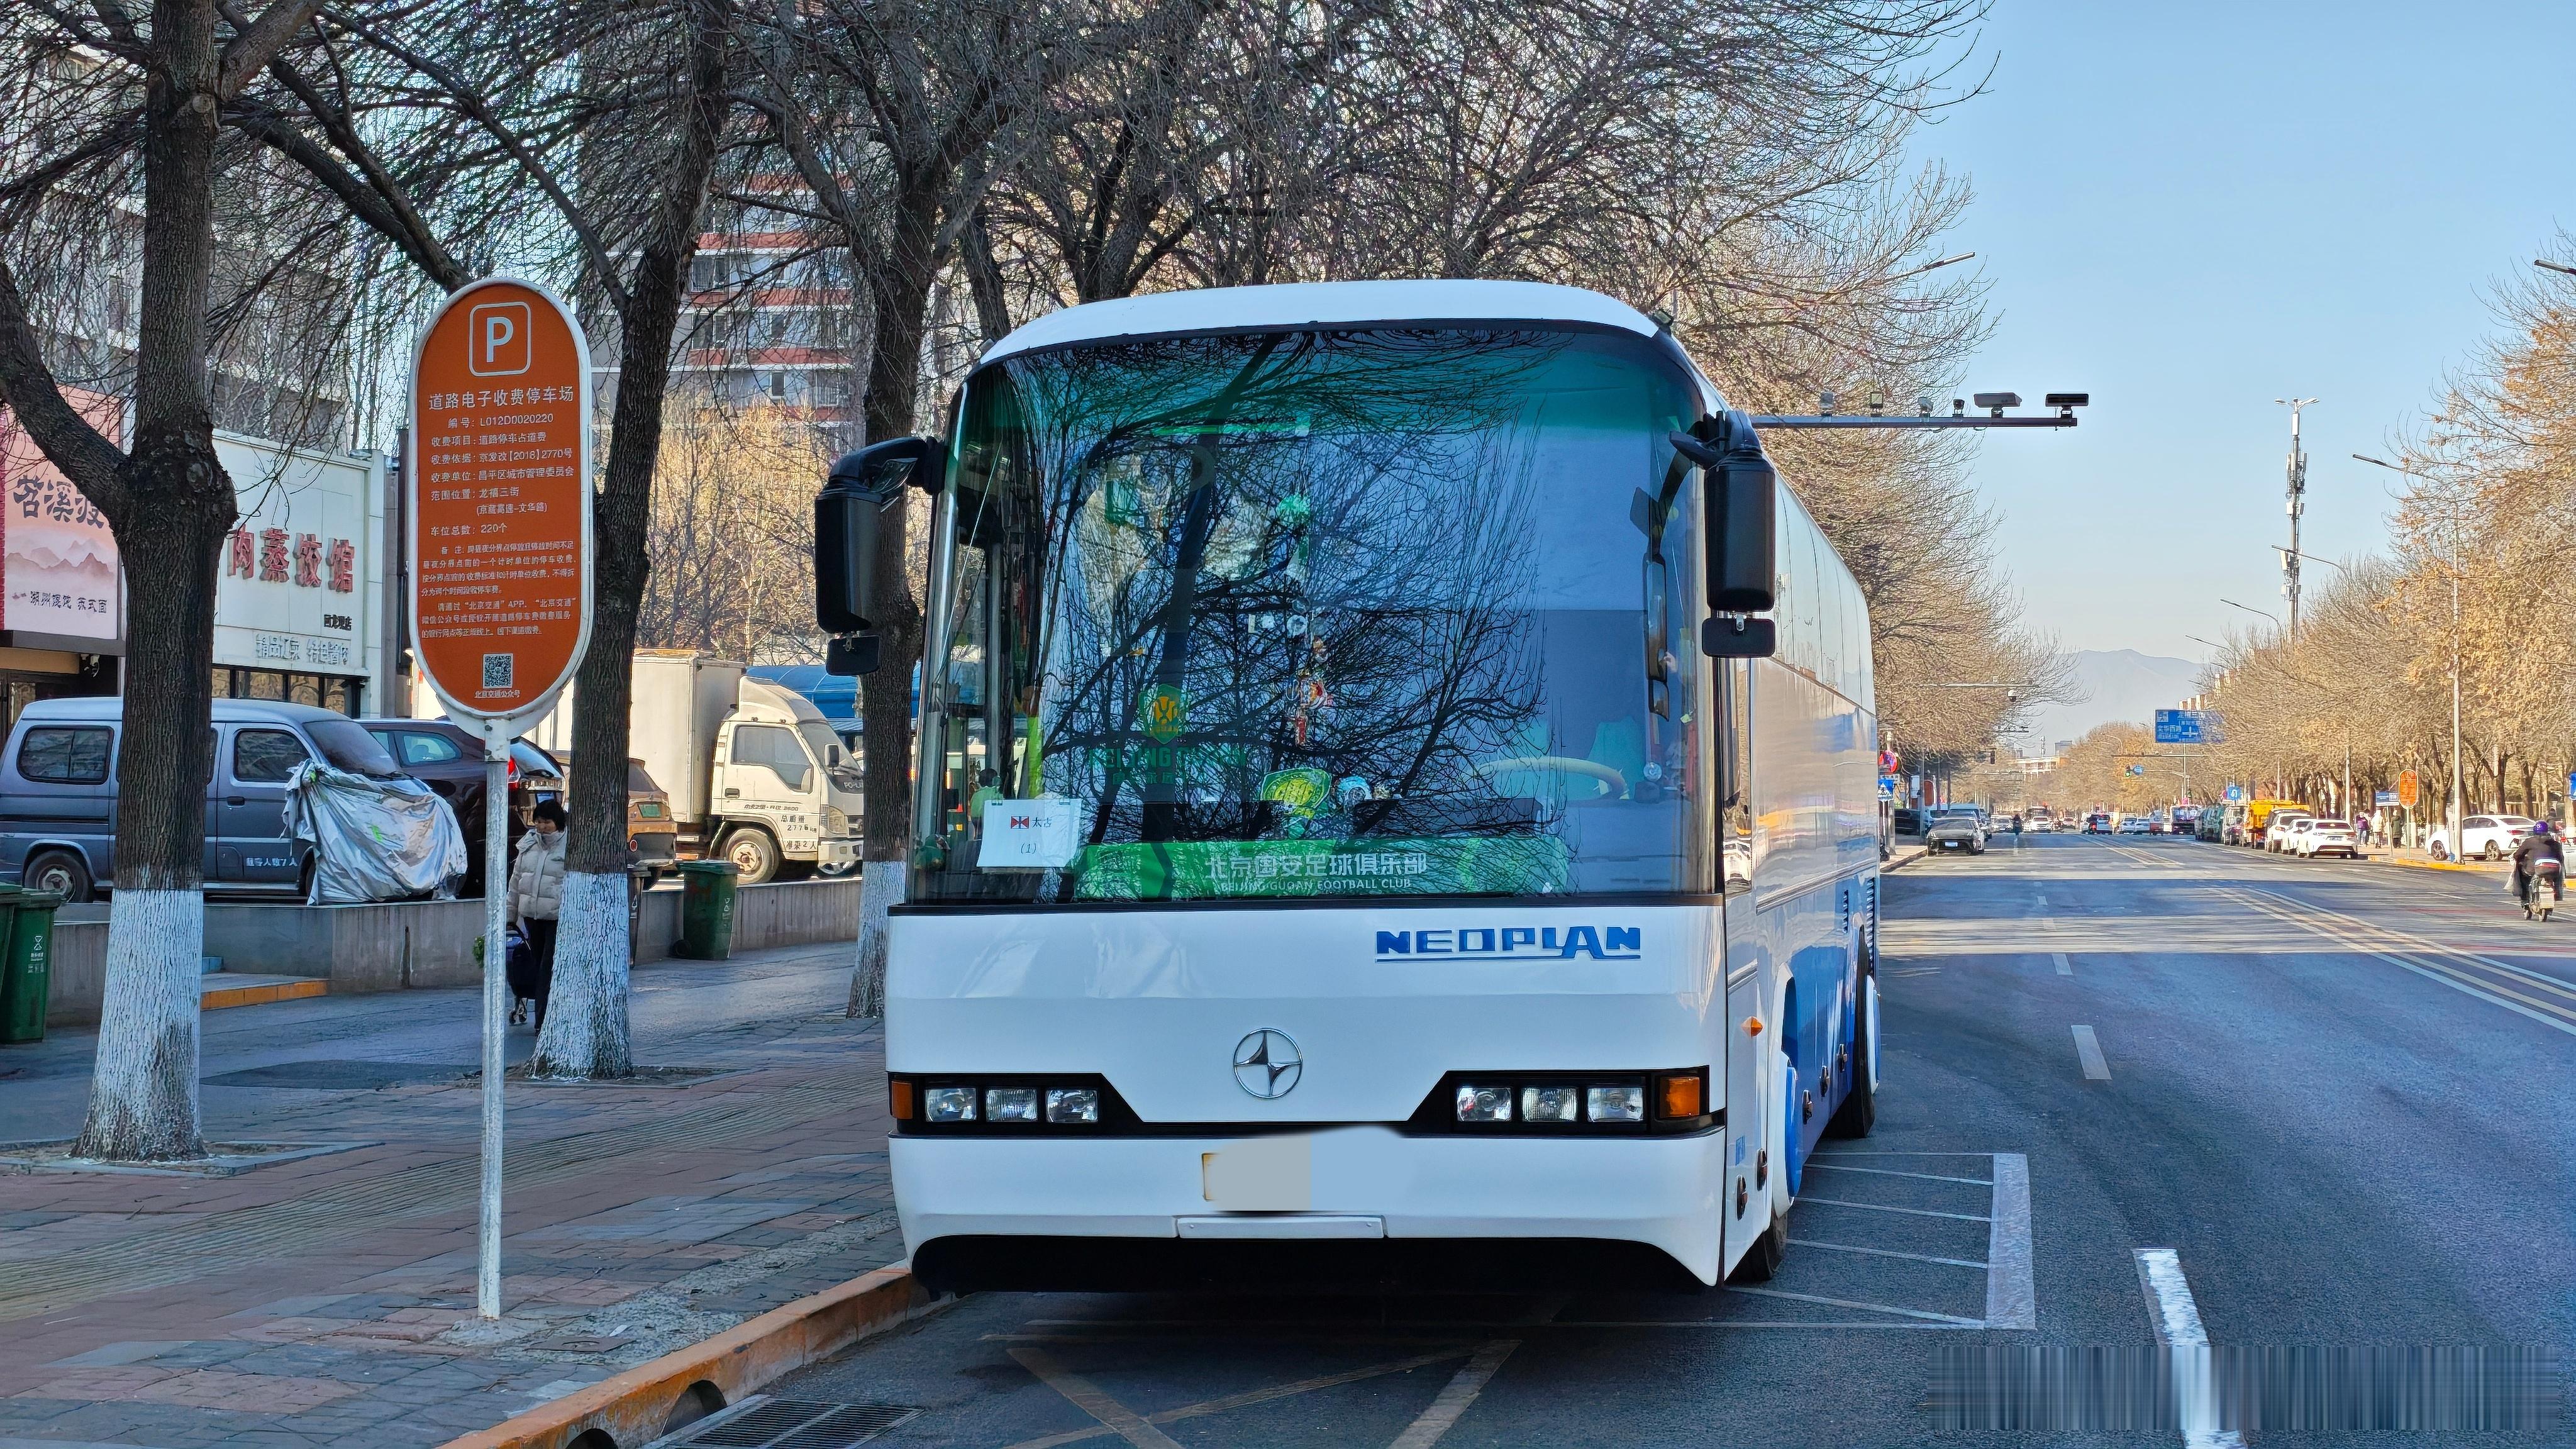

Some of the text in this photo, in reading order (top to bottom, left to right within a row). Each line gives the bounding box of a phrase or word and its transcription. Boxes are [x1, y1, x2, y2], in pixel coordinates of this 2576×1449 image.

[486, 316, 514, 363] P
[428, 386, 574, 411] 道路电子收费停车场
[1031, 816, 1052, 828] 太古
[1021, 842, 1036, 855] (1)
[1205, 852, 1428, 879] 北京国安足球俱乐部
[1221, 878, 1411, 892] BEIJING GUOAN FOOTBALL CLUB
[1376, 926, 1641, 960] NEOPLAN
